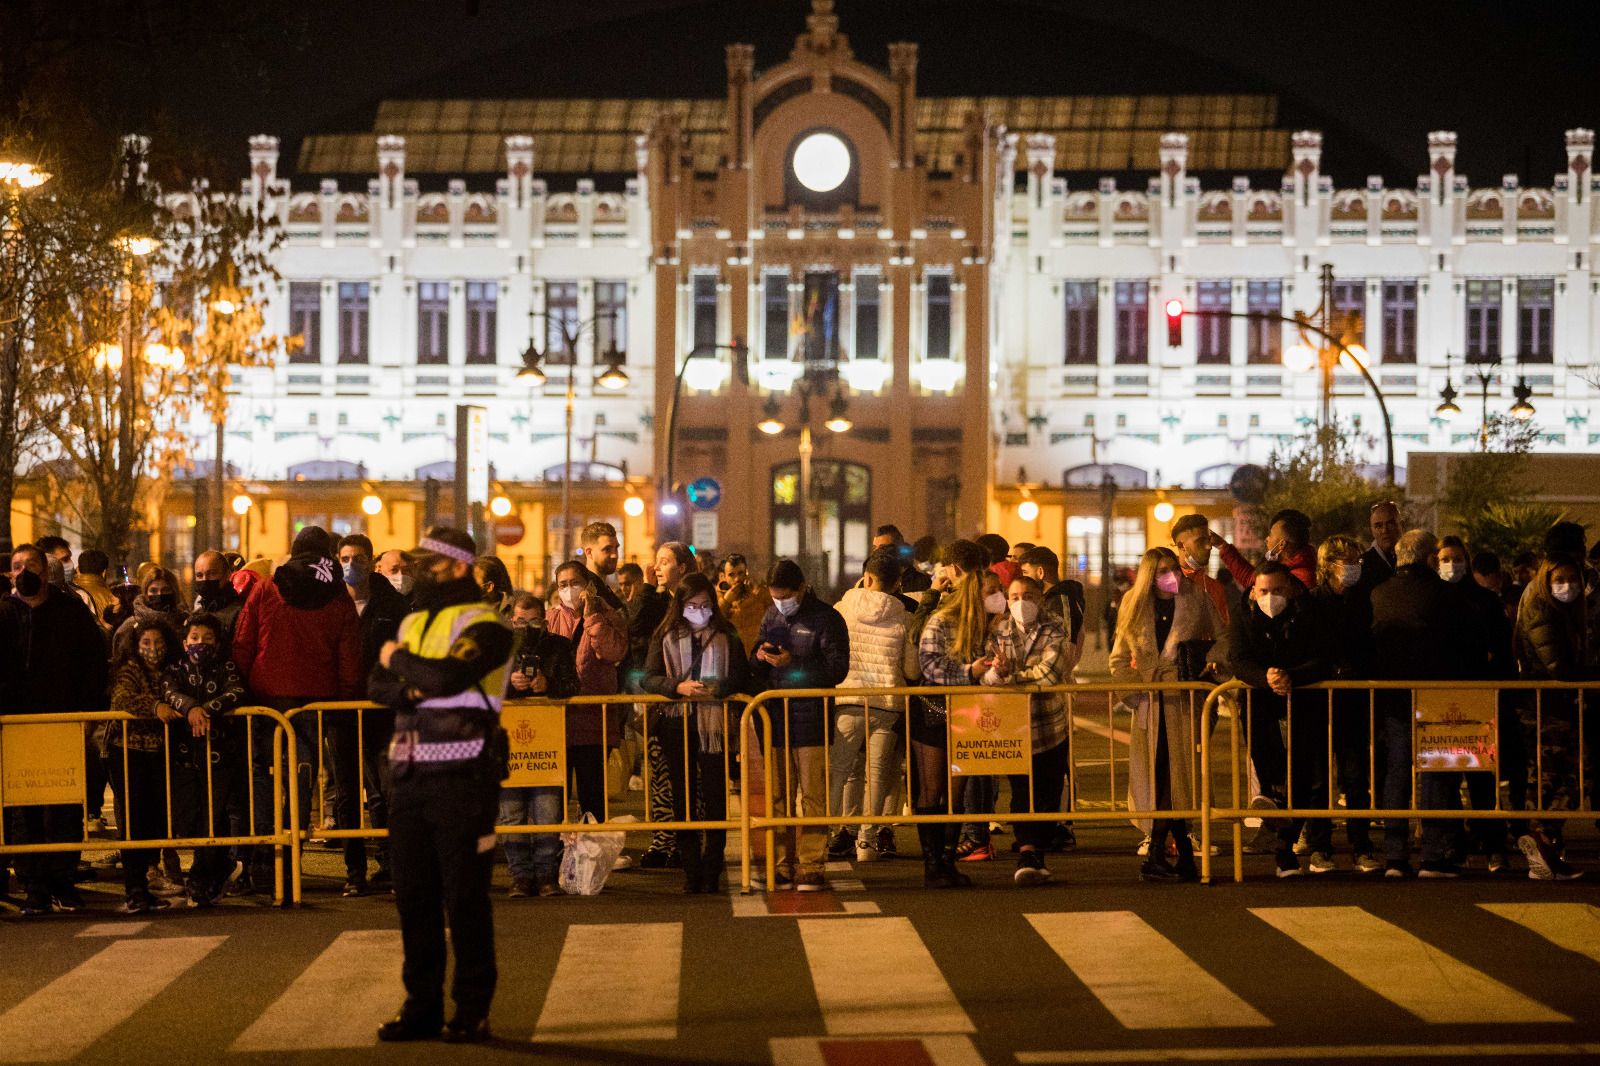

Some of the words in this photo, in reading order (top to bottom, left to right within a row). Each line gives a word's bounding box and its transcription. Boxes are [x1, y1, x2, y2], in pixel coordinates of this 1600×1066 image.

[1420, 735, 1489, 744] AJUNTAMENT
[956, 740, 1024, 749] AJUNTAMENT
[510, 751, 559, 761] NTAMENT
[956, 751, 970, 760] DE
[972, 749, 1023, 760] VALÈNCIA
